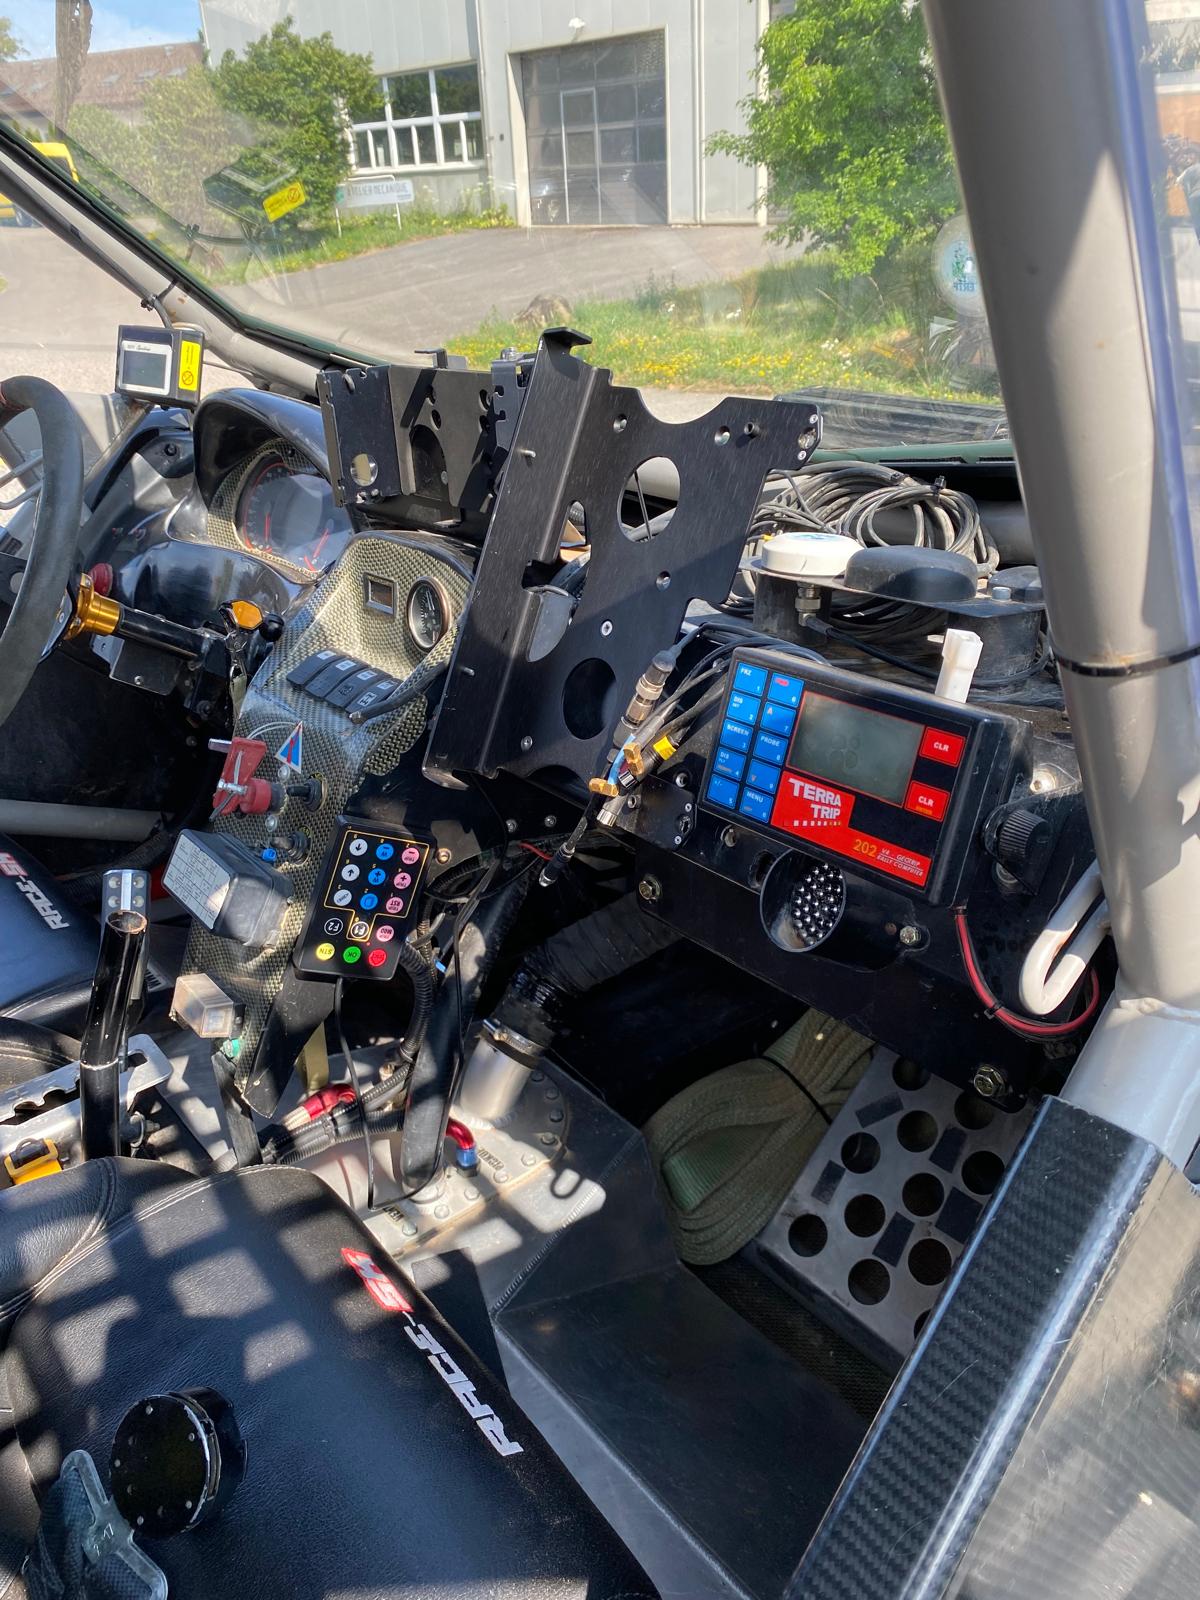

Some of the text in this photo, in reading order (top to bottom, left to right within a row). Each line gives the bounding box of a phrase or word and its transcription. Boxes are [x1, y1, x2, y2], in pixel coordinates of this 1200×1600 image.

[727, 724, 750, 736] SCREEN
[760, 735, 780, 747] PROBE
[933, 741, 949, 753] CLR
[746, 791, 763, 803] MENU
[788, 778, 841, 807] TERRA
[918, 795, 935, 807] CLR
[810, 803, 841, 819] TRIP
[853, 838, 878, 858] 202
[893, 861, 924, 877] COMPUTER
[327, 922, 340, 932] F2
[353, 925, 366, 935] F1
